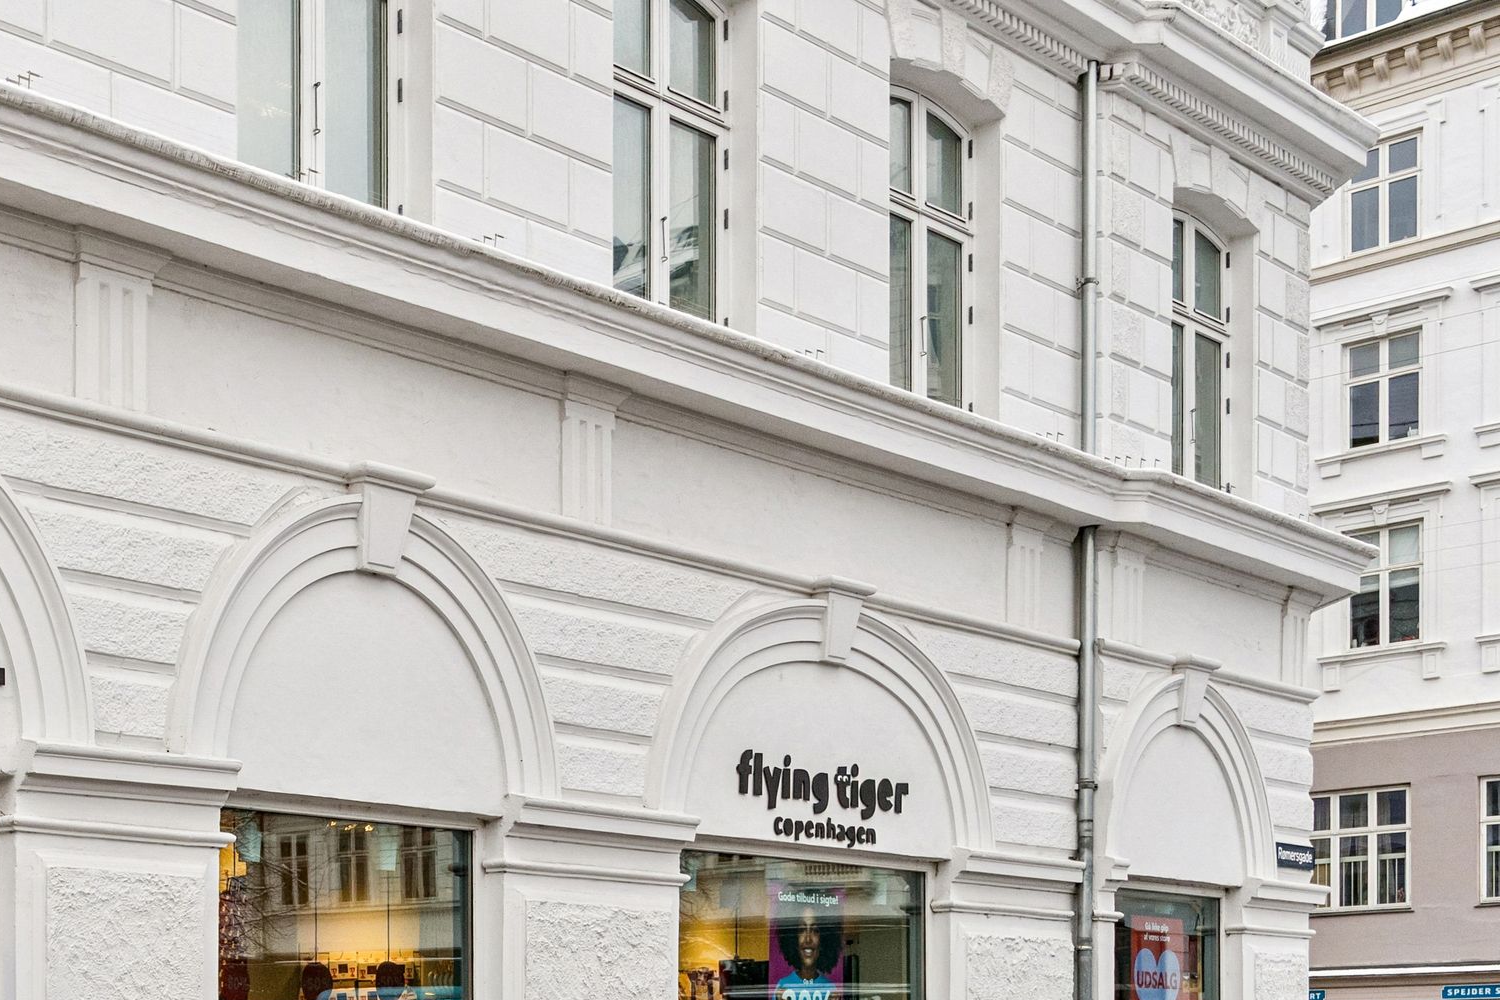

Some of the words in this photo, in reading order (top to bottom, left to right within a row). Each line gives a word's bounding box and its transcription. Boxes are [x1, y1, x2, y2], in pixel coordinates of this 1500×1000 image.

[736, 749, 829, 814] flying
[834, 764, 909, 820] tiger
[773, 816, 876, 848] copenhagen
[1278, 846, 1312, 864] Rømersgade
[778, 891, 795, 902] Gode
[1136, 970, 1178, 990] UDSALG
[1447, 986, 1491, 996] SPEJDER
